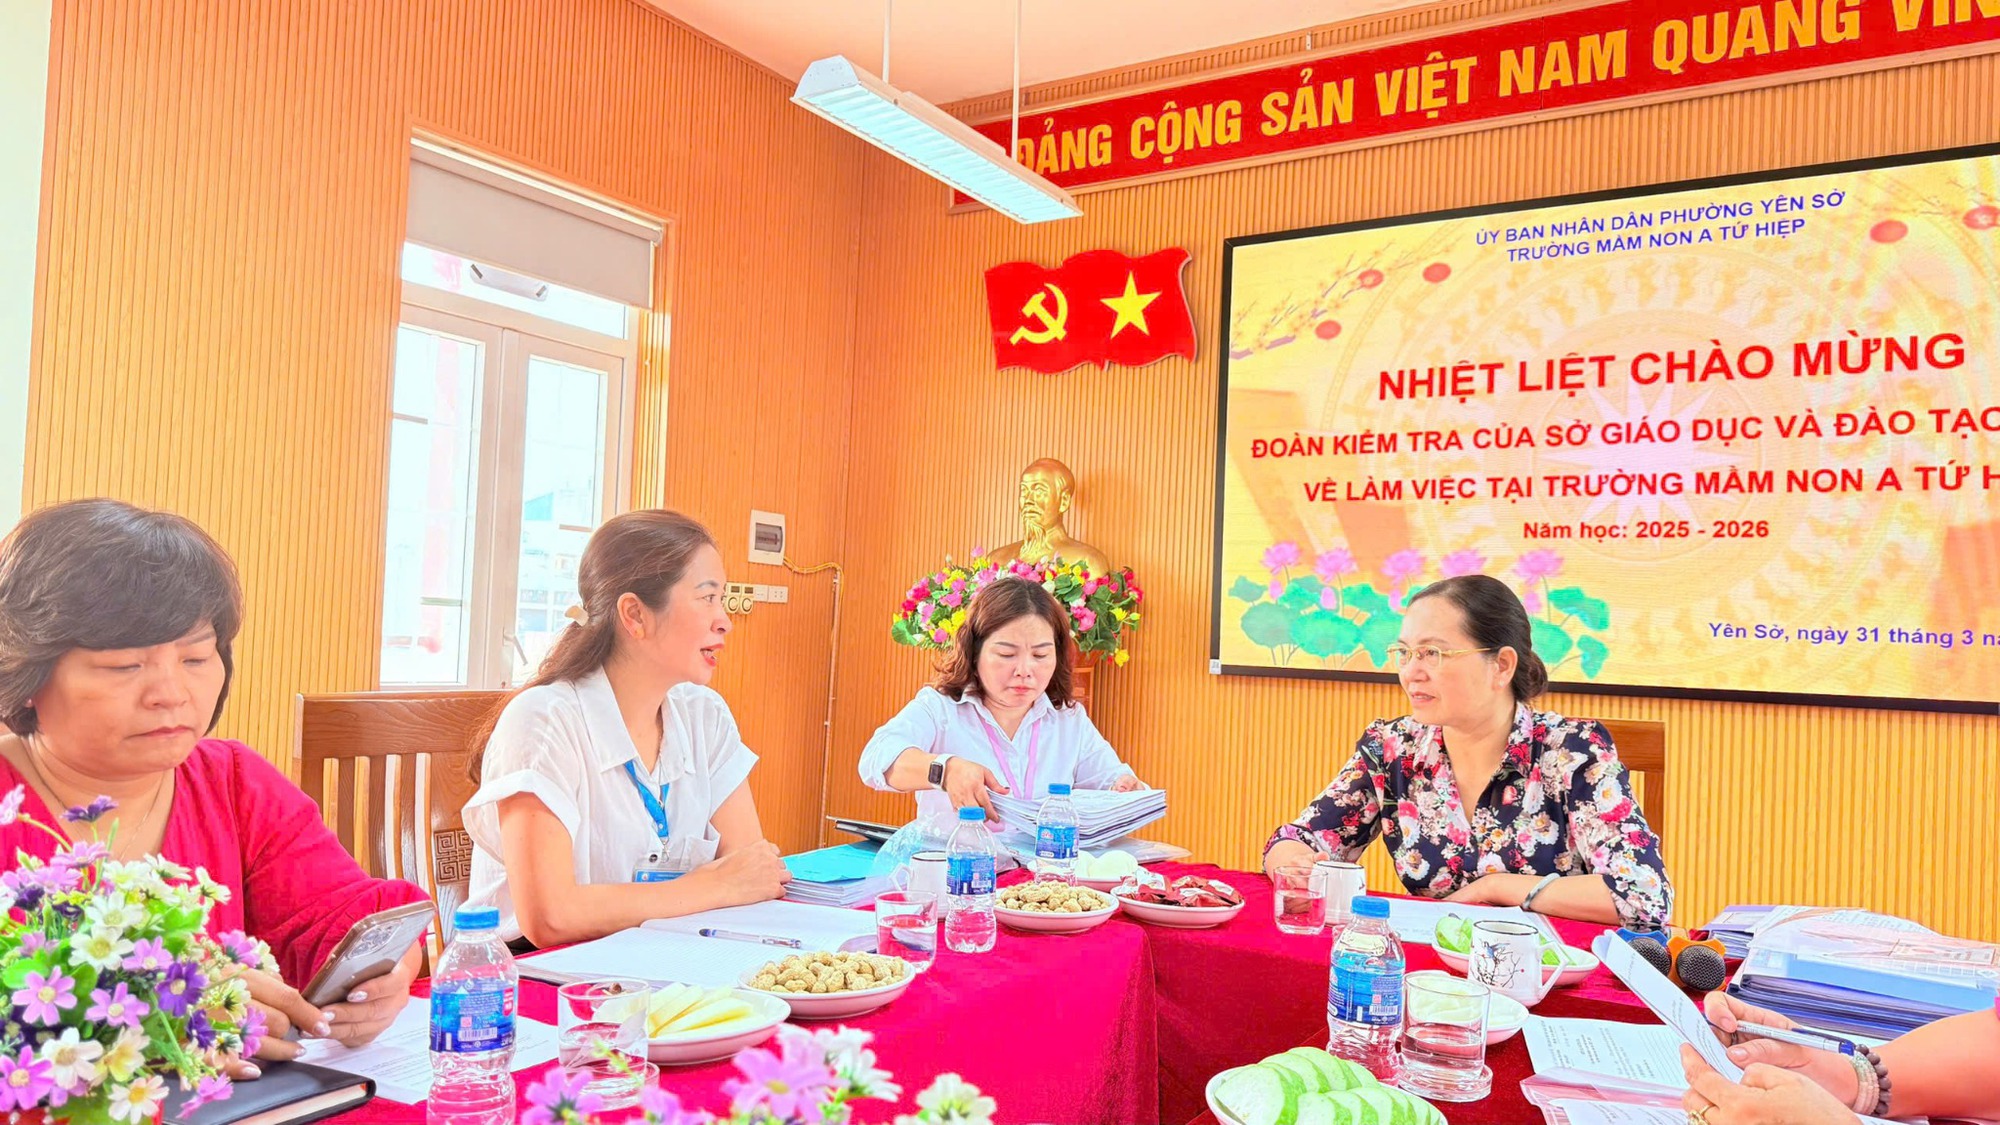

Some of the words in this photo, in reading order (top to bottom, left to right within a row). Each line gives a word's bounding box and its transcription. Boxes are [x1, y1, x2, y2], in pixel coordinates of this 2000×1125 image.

[1017, 117, 1112, 176] ĐẢNG
[1130, 101, 1241, 163] CỘNG
[1260, 67, 1354, 135] SẢN
[1375, 51, 1478, 119] VIỆT
[1499, 29, 1627, 97] NAM
[1652, 0, 1860, 74] QUANG
[1476, 228, 1499, 246] ỦY
[1505, 226, 1545, 242] BAN
[1550, 217, 1605, 237] NHÂN
[1611, 212, 1653, 231] DÂN
[1659, 201, 1753, 226] PHƯỜNG
[1760, 195, 1804, 214] YÊN
[1811, 190, 1846, 209] SỞ
[1508, 240, 1590, 262] TRƯỜNG
[1596, 235, 1643, 253] MẦM
[1649, 231, 1693, 247] NON
[1698, 229, 1714, 243] A
[1720, 224, 1749, 241] TỨ
[1755, 217, 1807, 238] HIỆP
[1378, 360, 1505, 404] NHIỆT
[1518, 352, 1616, 398] LIỆT
[1630, 339, 1774, 385] CHÀO
[1792, 329, 1965, 377] MỪNG
[1251, 432, 1324, 458] ĐOÀN
[1333, 428, 1398, 455] KIỂM
[1407, 429, 1463, 452] TRA
[1473, 422, 1535, 450] CỦA
[1545, 418, 1592, 446] SỞ
[1601, 415, 1681, 445] GIÁO
[1692, 416, 1764, 447] DỤC
[1774, 407, 1823, 439] VÀ
[1833, 405, 1916, 437] ĐÀO
[1928, 406, 2000, 440] TẠO
[1304, 477, 1338, 502] VỀ
[1346, 476, 1403, 502] LÀM
[1411, 475, 1477, 505] VIỆC
[1486, 476, 1533, 504] TẠI
[1543, 468, 1683, 497] TRƯỜNG
[1695, 465, 1774, 495] MẦM
[1786, 468, 1864, 493] NON
[1876, 467, 1903, 491] A
[1914, 459, 1971, 491] TỨ
[1523, 521, 1572, 539] Năm
[1580, 521, 1628, 543] học:
[1636, 520, 1690, 538] 2025
[1712, 520, 1769, 538] 2026
[1709, 622, 1747, 638] Yên
[1754, 624, 1790, 643] Sở,
[1797, 626, 1849, 645] ngày
[1856, 627, 1879, 642] 31
[1889, 628, 1953, 649] tháng
[1961, 629, 1975, 645] 3
